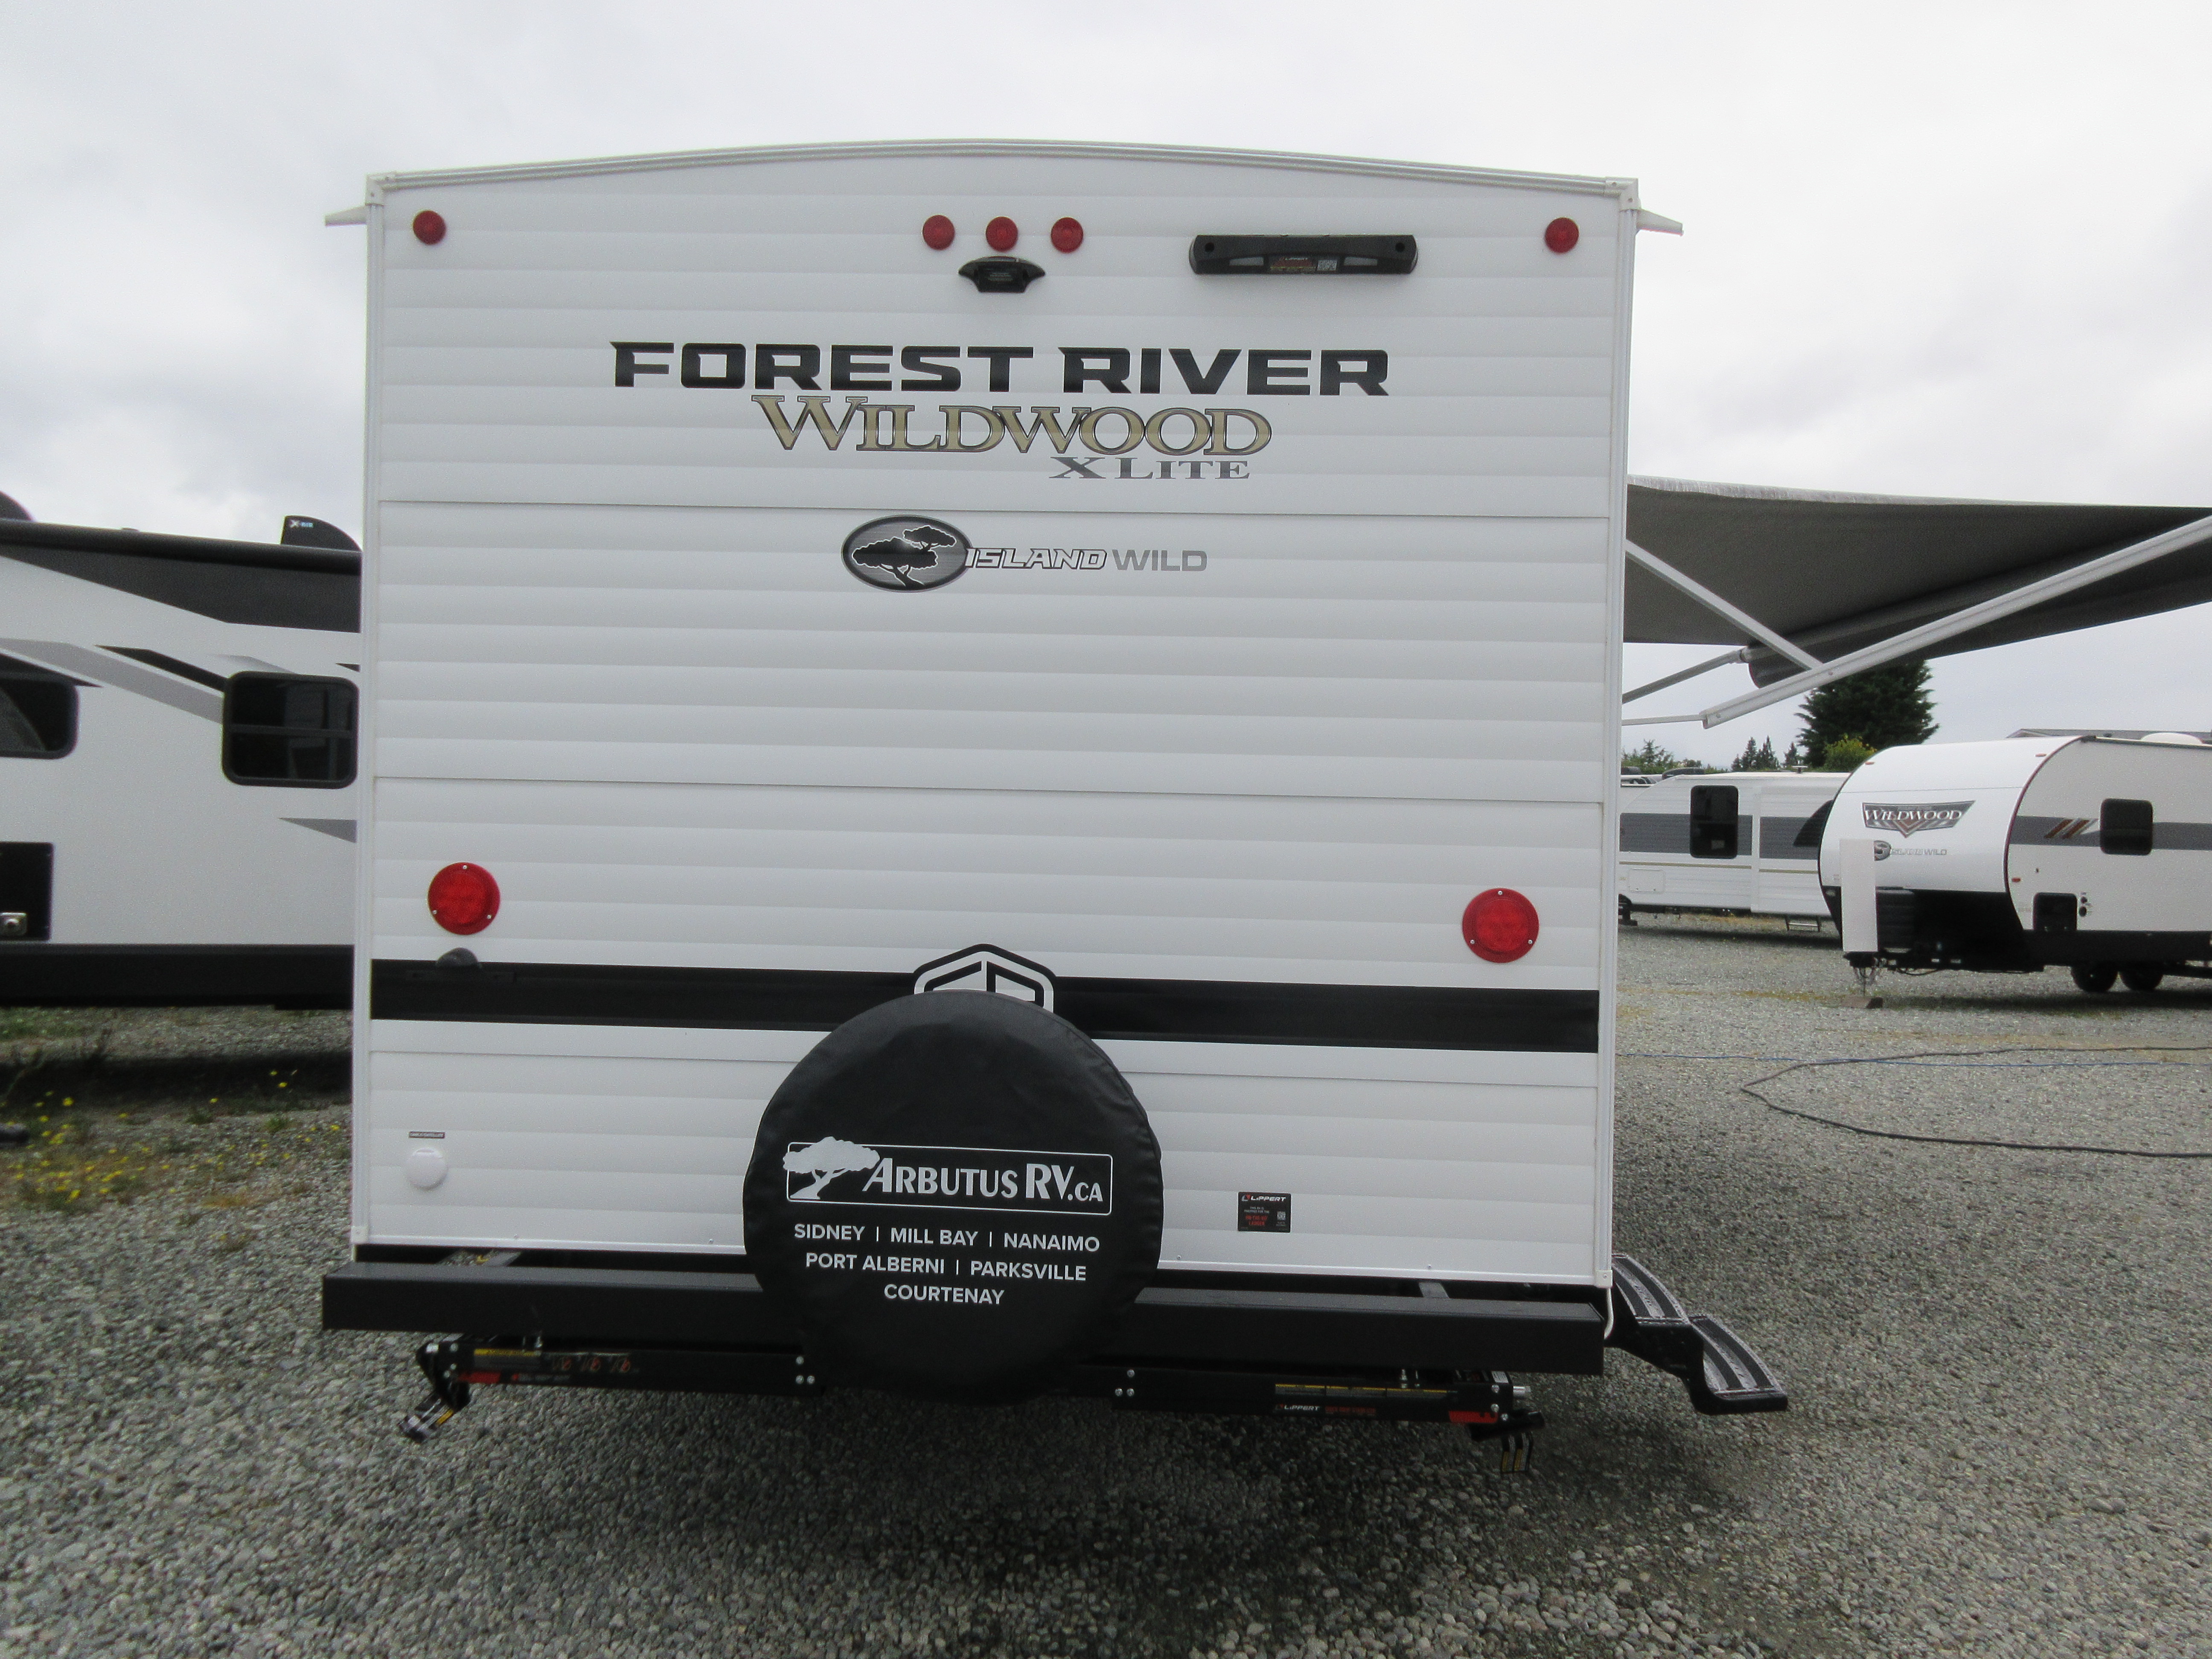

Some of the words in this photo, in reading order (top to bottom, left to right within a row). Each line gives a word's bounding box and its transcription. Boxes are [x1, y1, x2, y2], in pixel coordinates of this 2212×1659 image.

[612, 341, 1034, 392] FOREST
[1058, 347, 1389, 396] RIVER
[751, 395, 1272, 456] WILDWOOD
[964, 547, 1108, 570] ISLAND
[1111, 549, 1208, 572] WILD
[794, 1223, 865, 1240] SIDNEY
[890, 1227, 934, 1244] MILL
[940, 1229, 978, 1246] BAY
[1004, 1232, 1100, 1252] NANAIMO
[806, 1252, 857, 1269] PORT
[862, 1254, 945, 1274] ALBERNI
[970, 1260, 1087, 1281] PARKSVILLE
[884, 1284, 1005, 1305] COURTENAY
